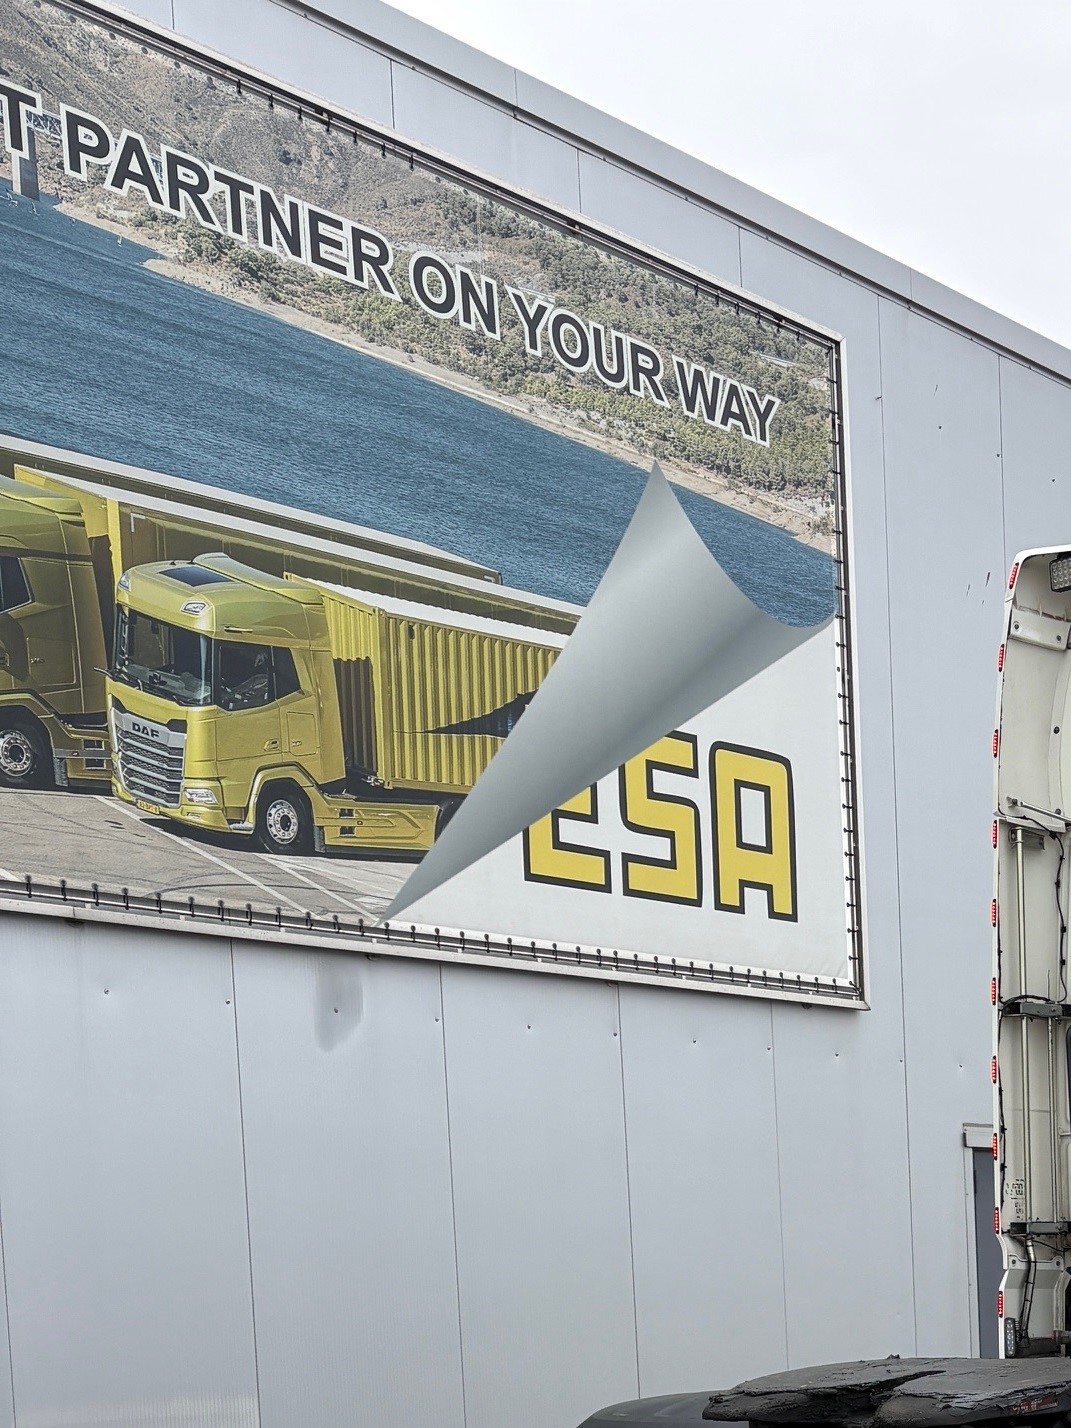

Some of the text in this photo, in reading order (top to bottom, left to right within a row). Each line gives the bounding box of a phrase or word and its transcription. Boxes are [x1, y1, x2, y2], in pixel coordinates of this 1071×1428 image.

[61, 103, 401, 301] PARTNER
[410, 251, 500, 340] ON
[505, 285, 670, 407] YOUR
[672, 356, 779, 446] WAY
[132, 721, 160, 740] DAF
